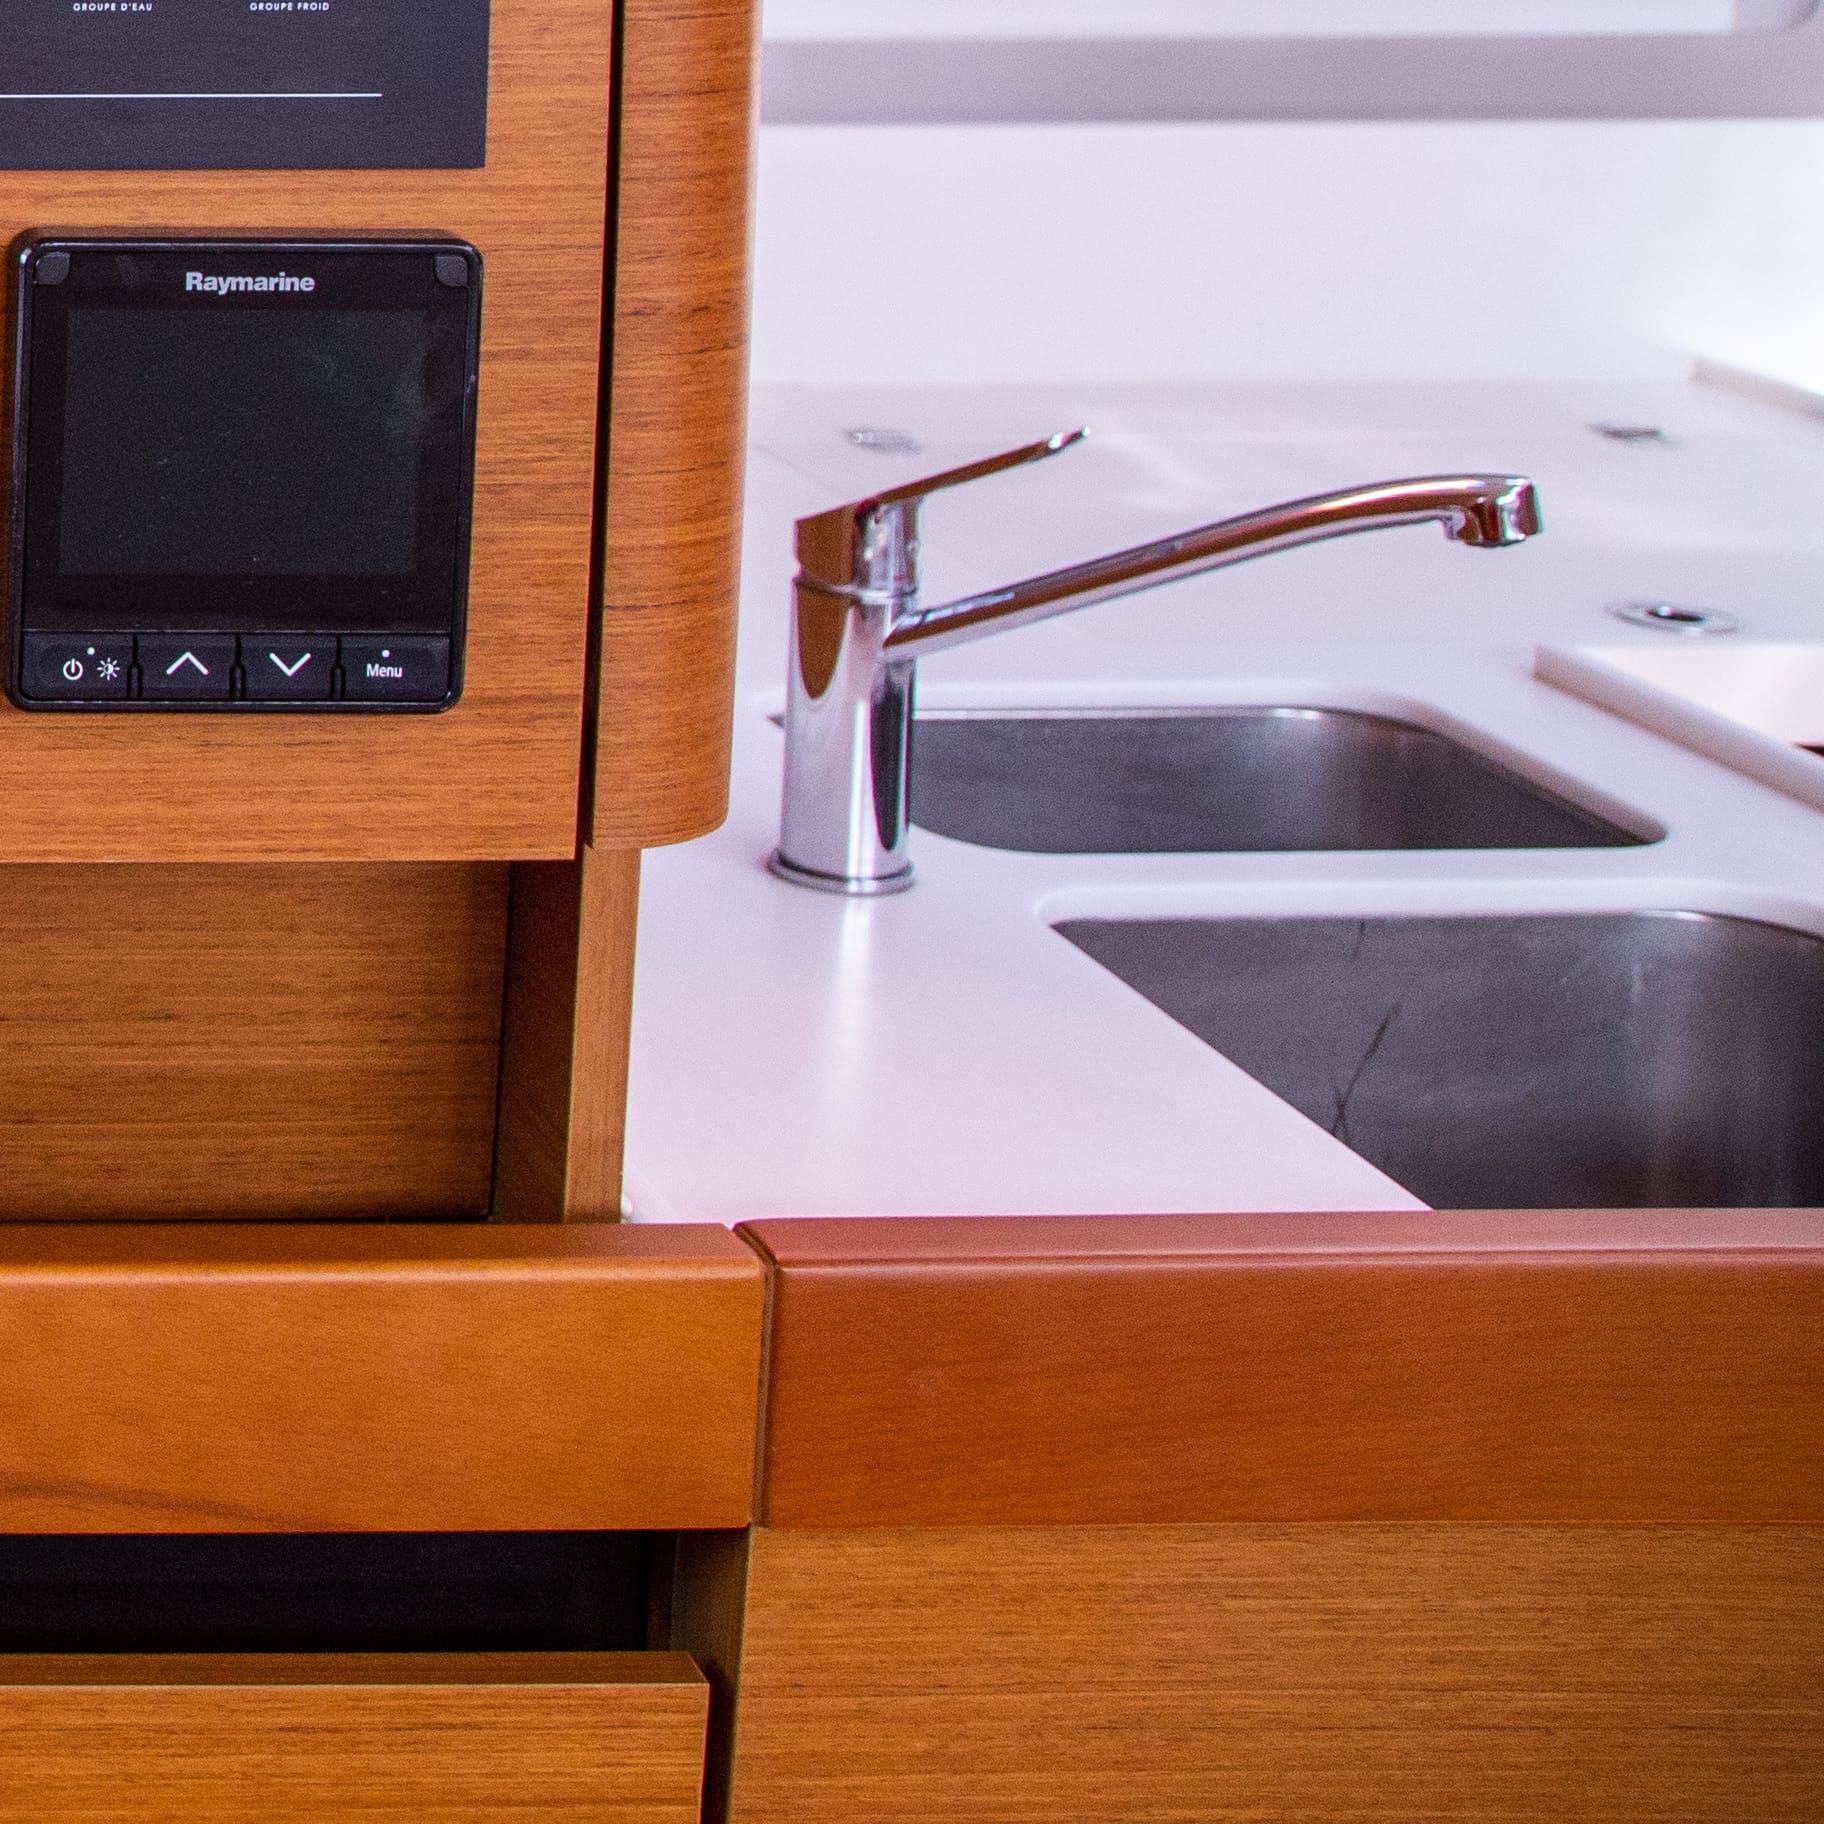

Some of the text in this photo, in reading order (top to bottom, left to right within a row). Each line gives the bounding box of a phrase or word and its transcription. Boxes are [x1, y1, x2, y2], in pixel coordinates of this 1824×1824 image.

[73, 3, 152, 11] GROUPE D'EAU
[297, 2, 329, 10] FROID
[185, 271, 315, 293] Raymarine
[366, 663, 403, 679] Menu
